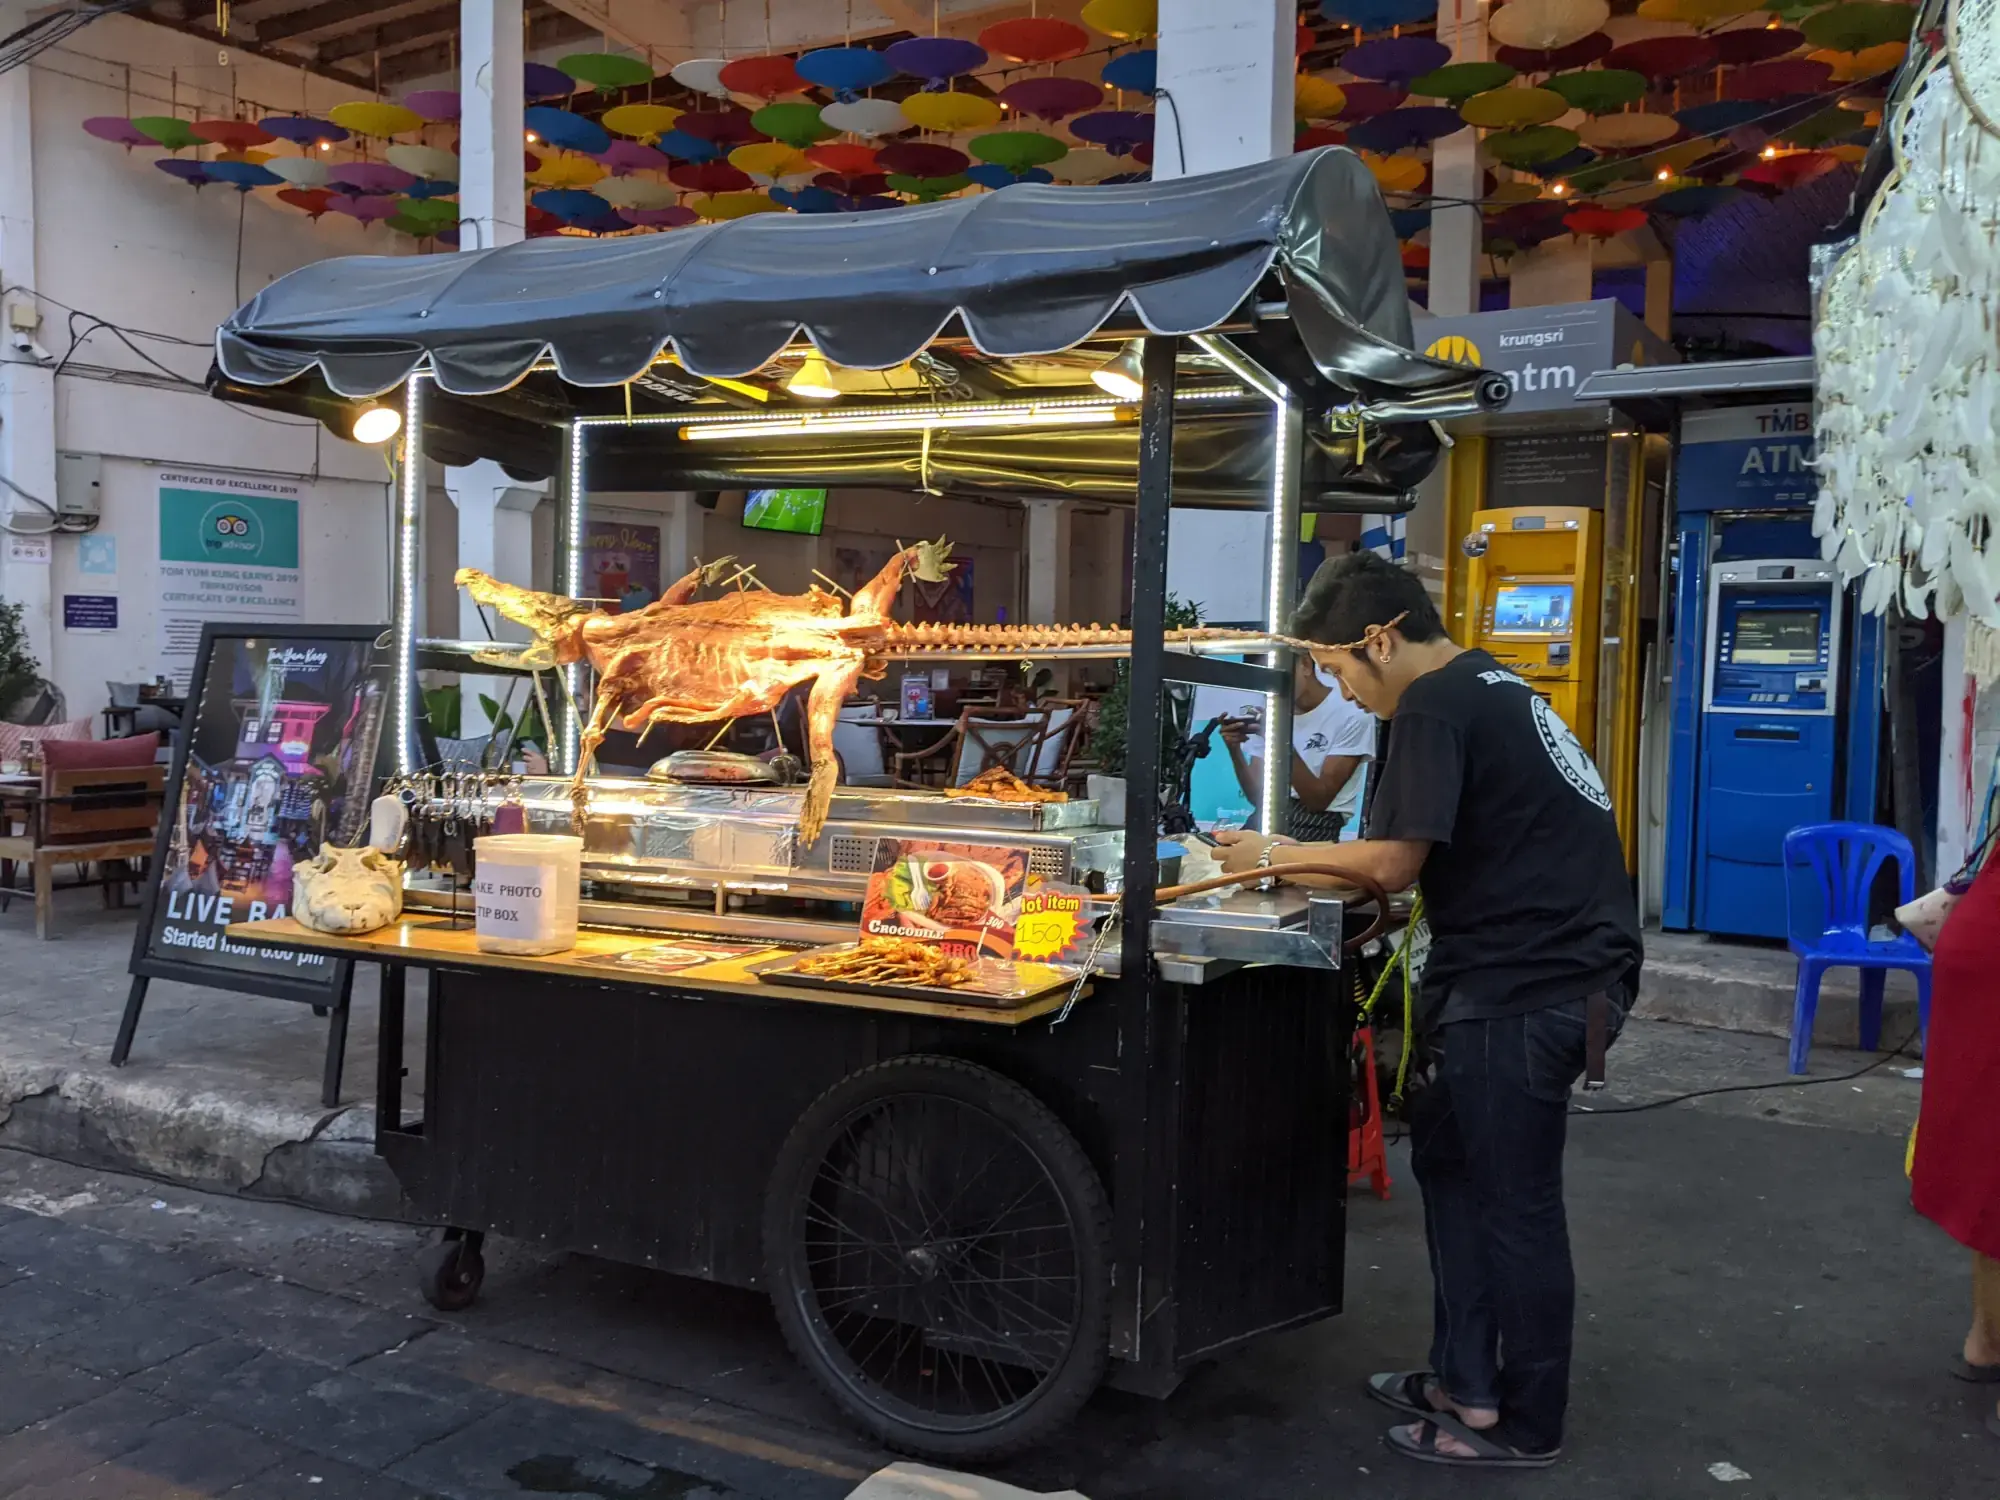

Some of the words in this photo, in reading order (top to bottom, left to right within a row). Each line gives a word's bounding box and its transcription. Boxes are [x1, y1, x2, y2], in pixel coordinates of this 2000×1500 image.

[1500, 328, 1564, 347] krungsri
[1502, 362, 1576, 392] atm
[1756, 408, 1809, 433] TMB
[161, 473, 213, 485] CERTIFICATE
[228, 480, 277, 492] EXCELLENCE
[280, 485, 298, 494] 2019
[160, 566, 184, 576] TOM
[186, 567, 209, 577] YUM
[211, 570, 240, 580] KUNG
[242, 572, 273, 582] EARNS
[200, 580, 263, 592] TRIPADVISOR
[162, 591, 223, 603] CERTIFICATE
[225, 596, 238, 604] OF
[240, 596, 296, 606] EXCELLENCE
[499, 884, 542, 898] PHOTO
[166, 890, 234, 925] LIVE
[248, 900, 289, 923] BA
[1047, 895, 1080, 911] item
[494, 908, 519, 921] BOX
[162, 926, 218, 951] Started
[868, 919, 944, 939] CROCODILE
